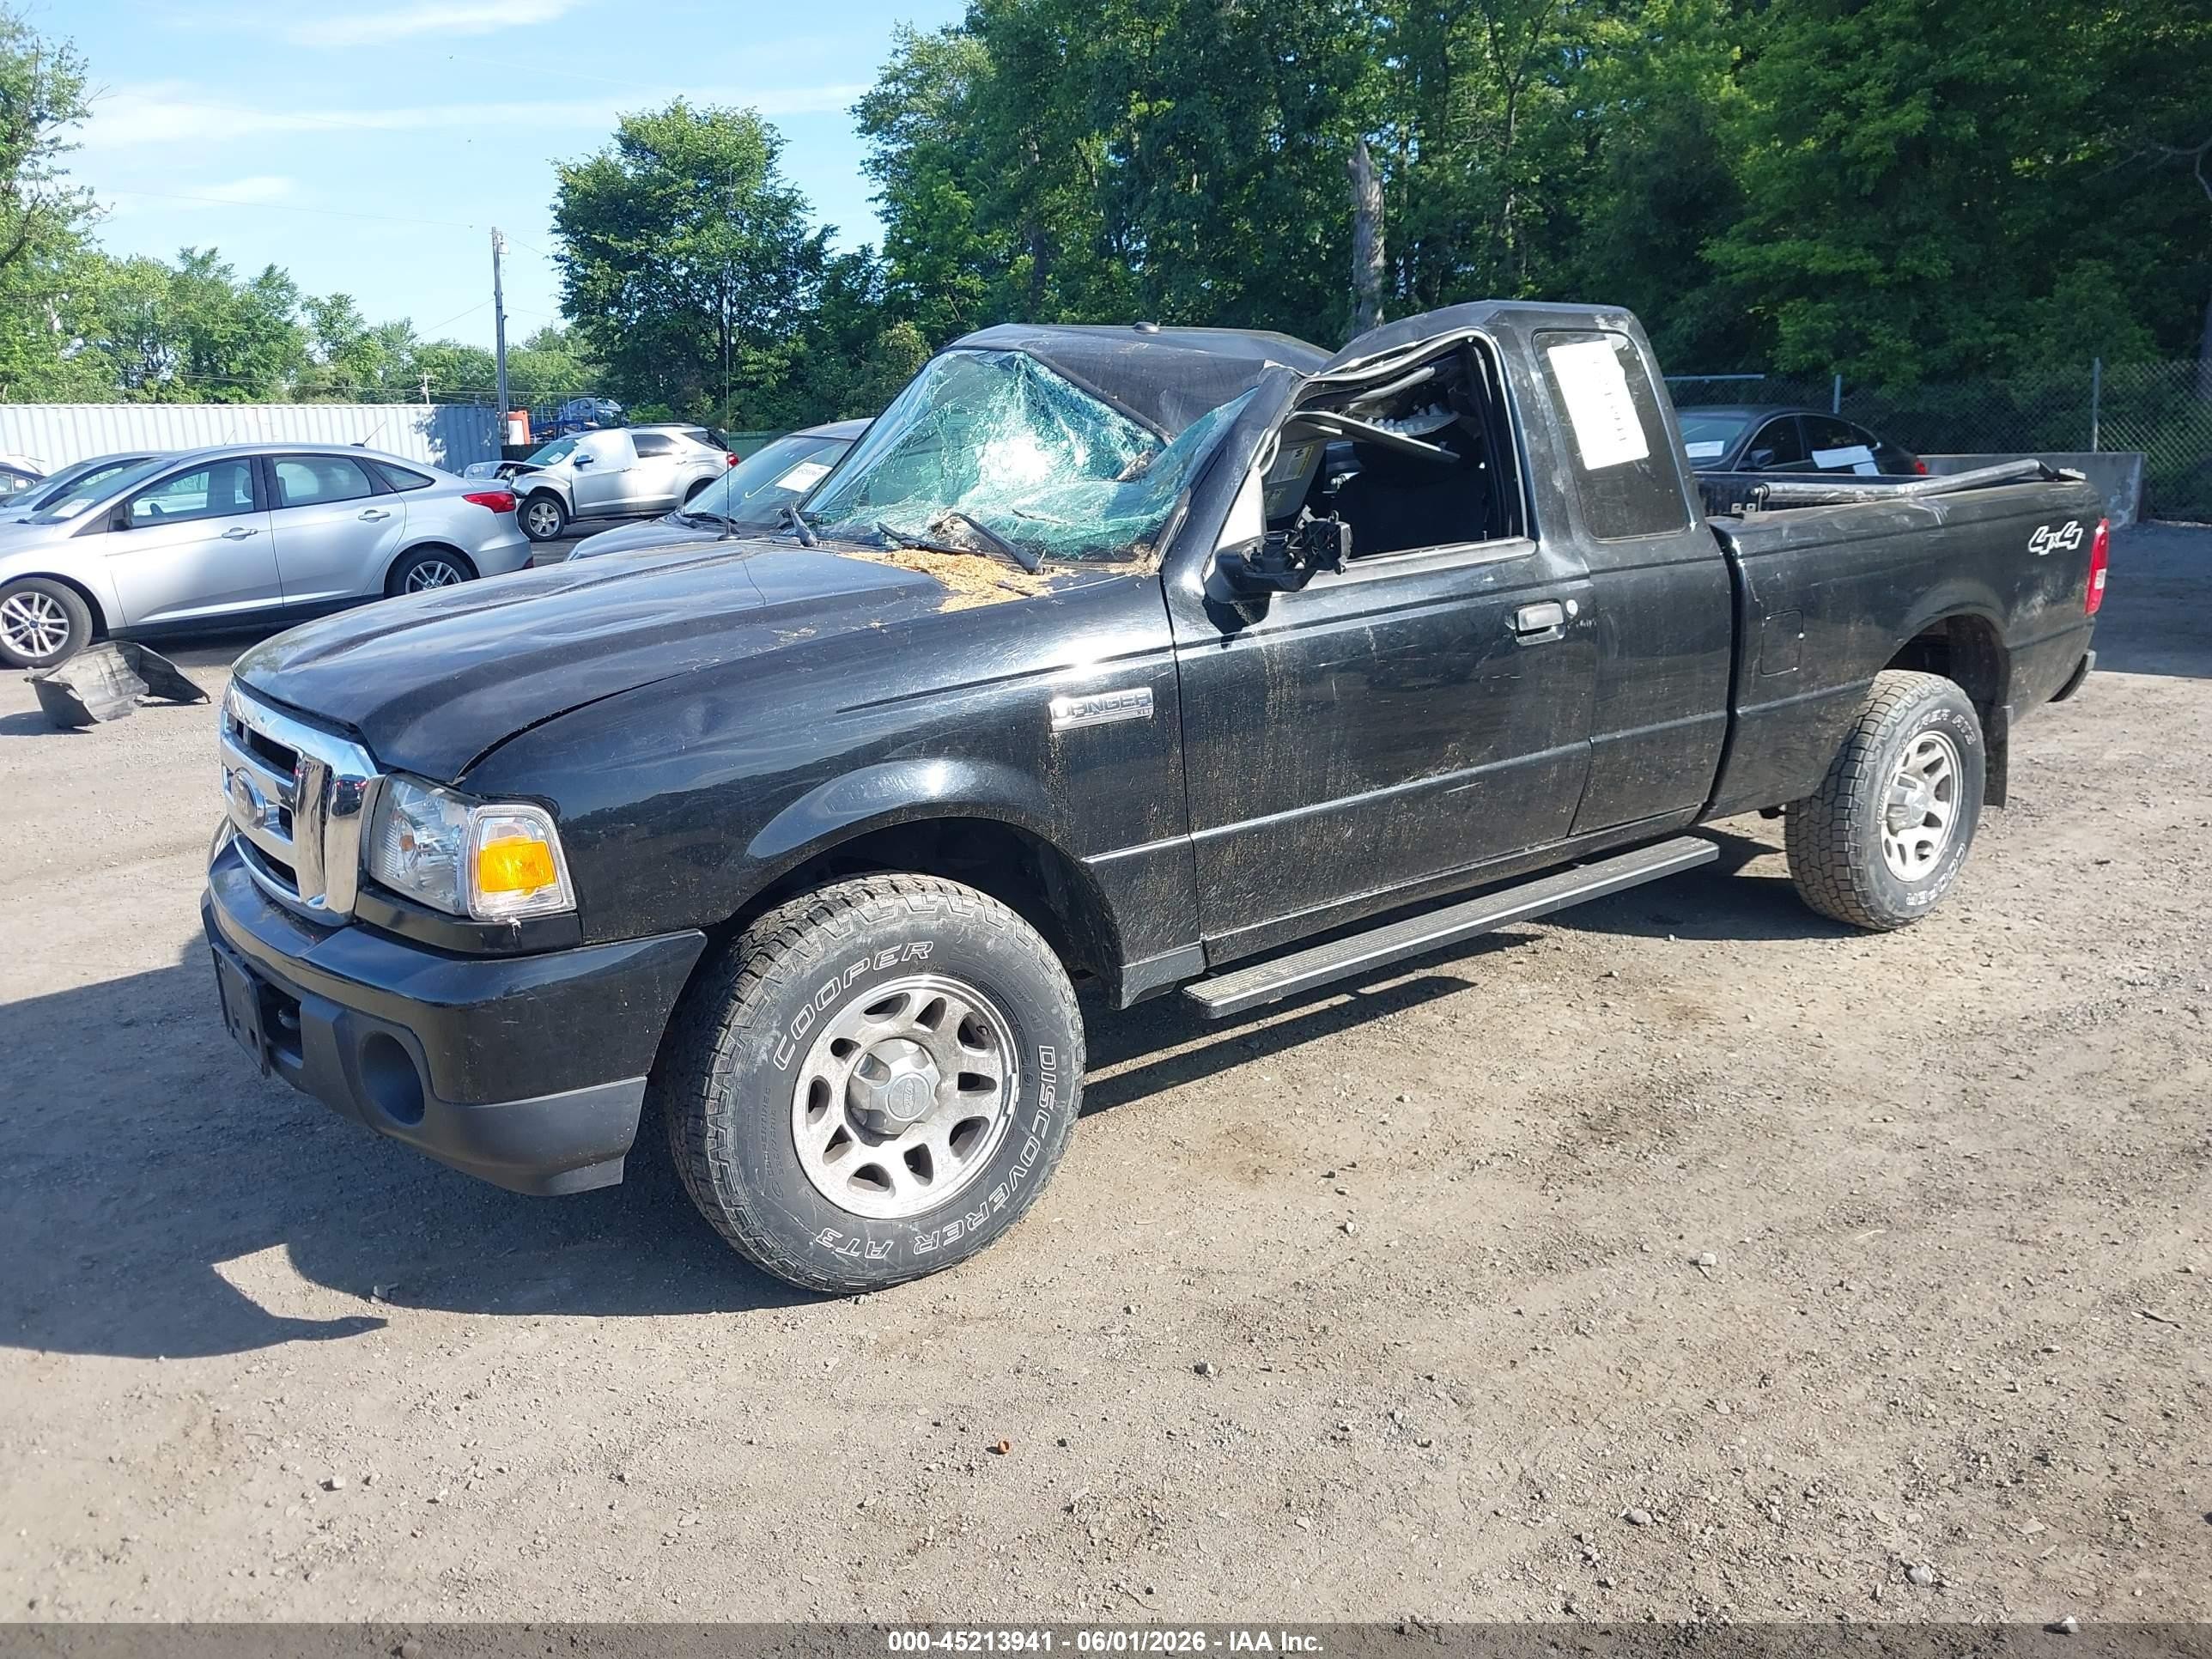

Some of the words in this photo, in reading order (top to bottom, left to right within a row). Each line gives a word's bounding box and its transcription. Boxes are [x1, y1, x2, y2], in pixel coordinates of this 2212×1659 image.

[2028, 520, 2084, 556] 4x4
[1905, 842, 1966, 906] COOPER
[773, 941, 933, 1070] COOPER
[914, 1045, 1056, 1254] DISCOVERER
[816, 1228, 893, 1259] AT3
